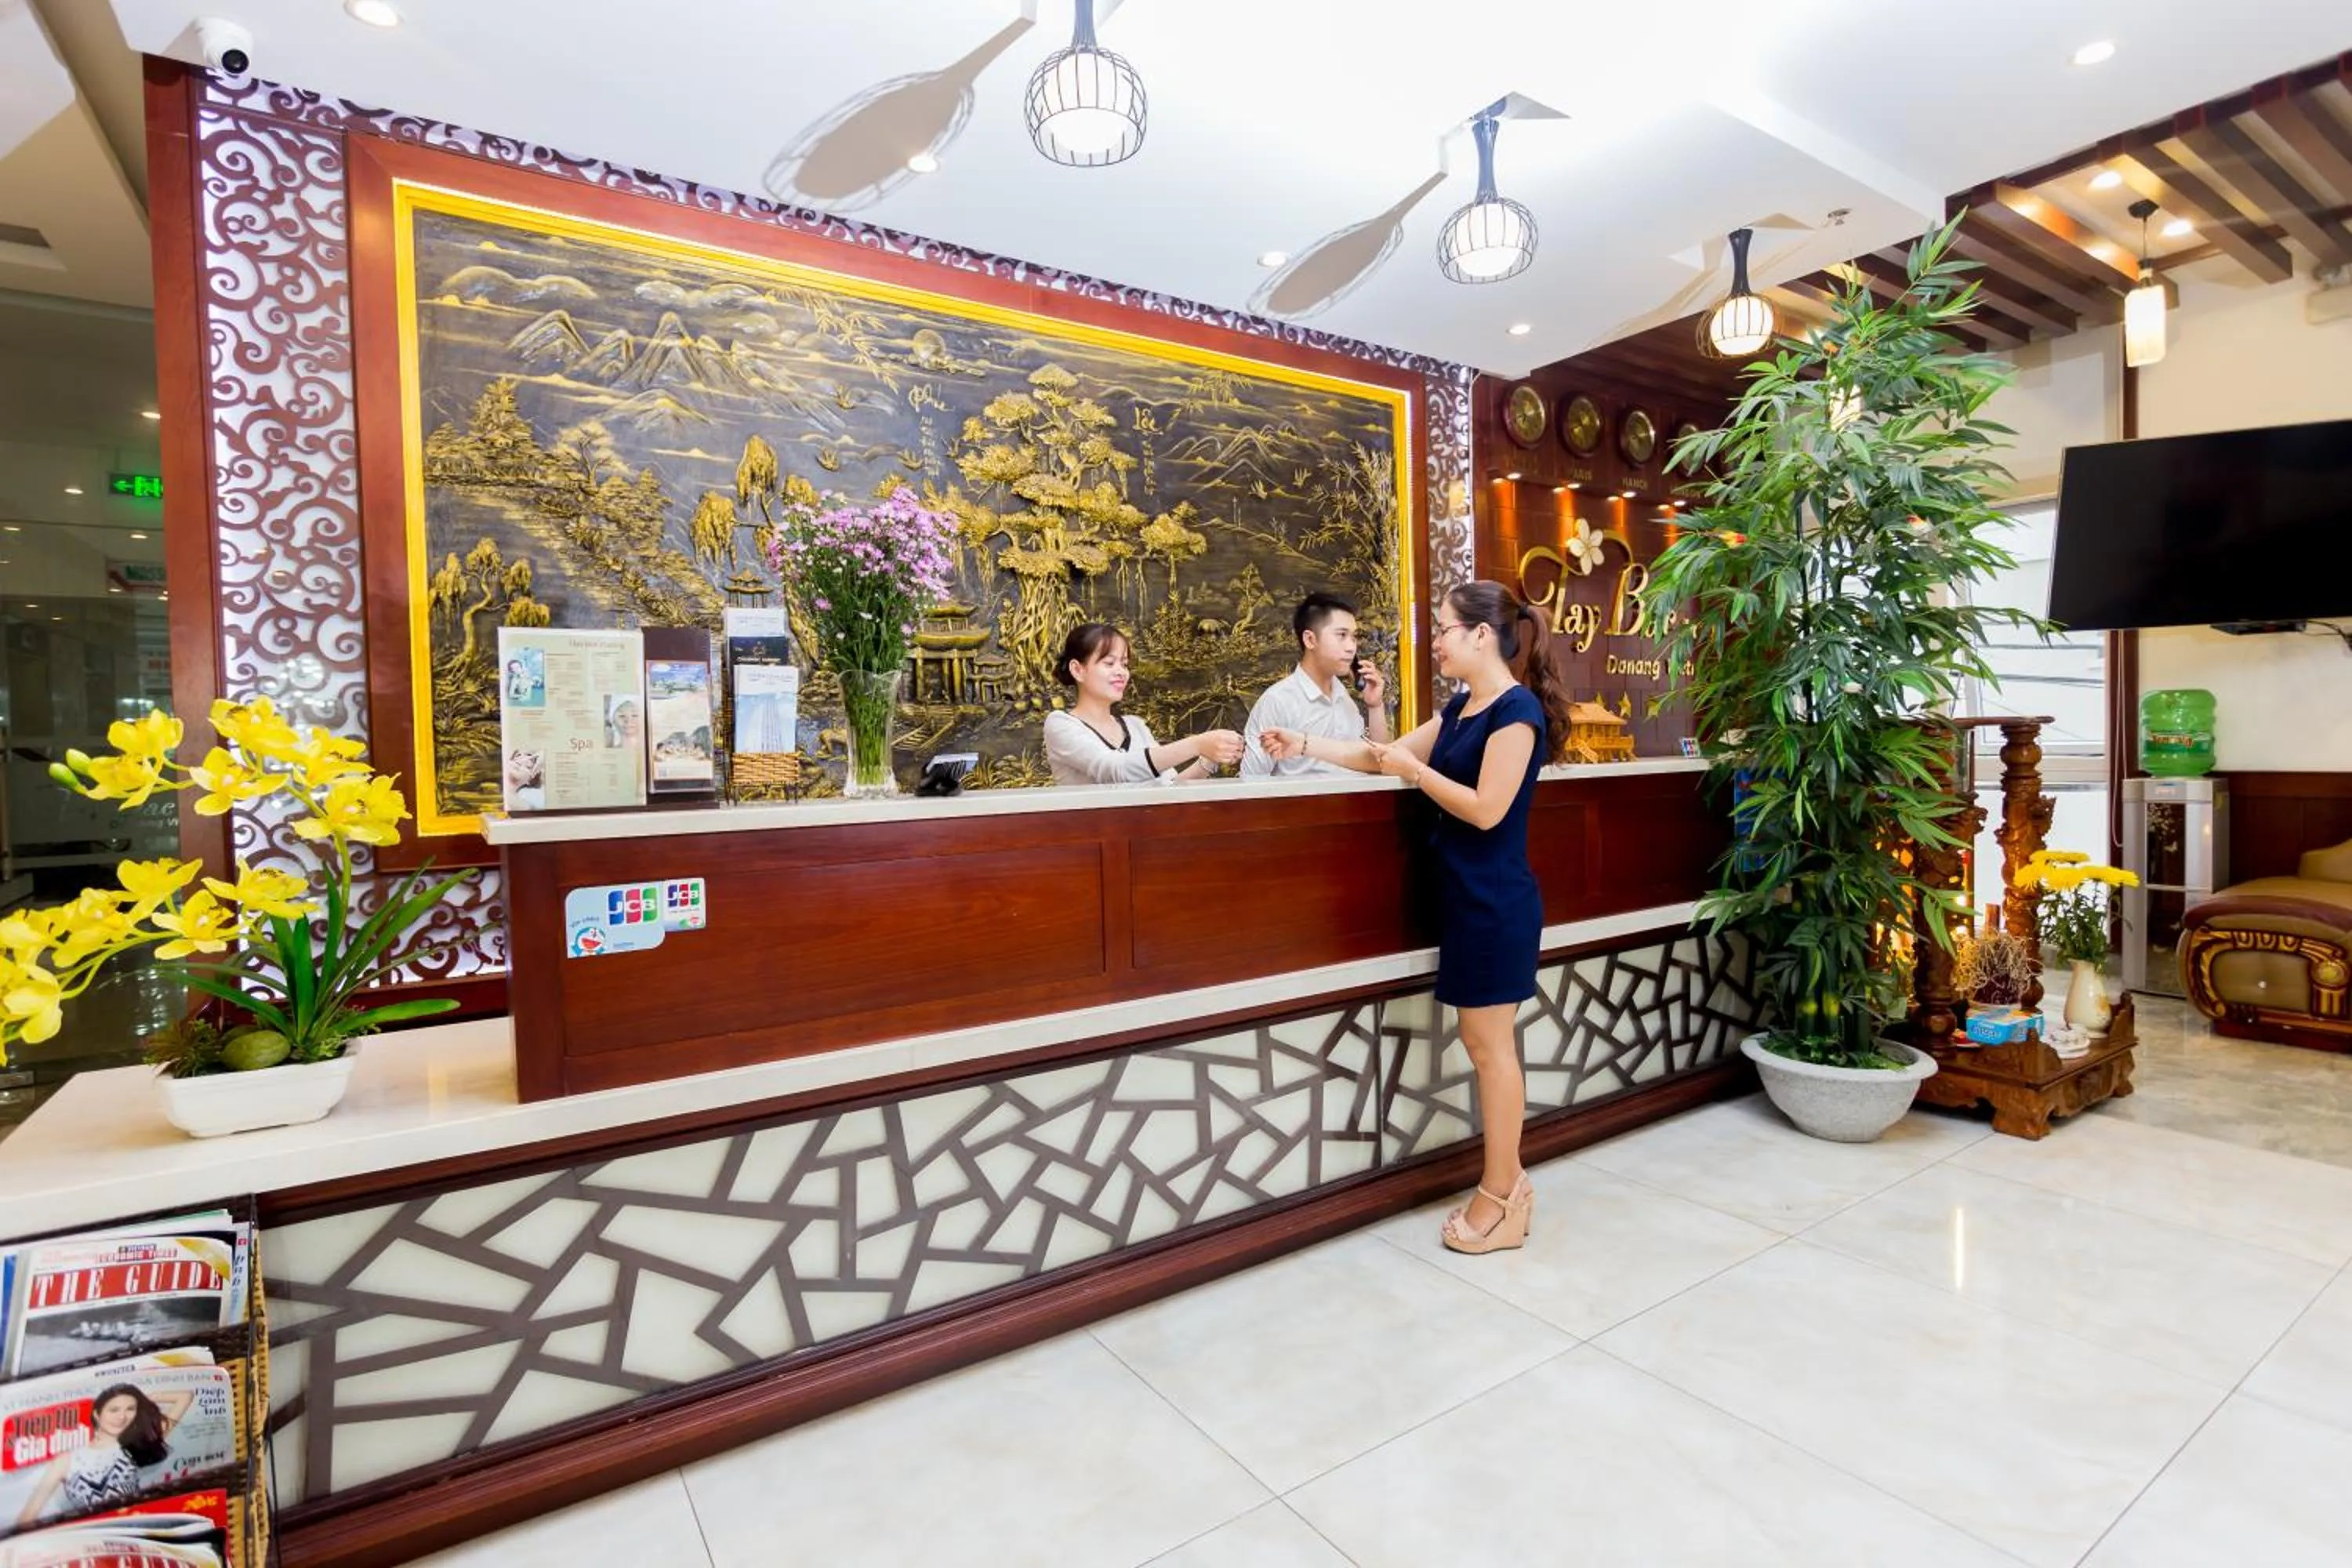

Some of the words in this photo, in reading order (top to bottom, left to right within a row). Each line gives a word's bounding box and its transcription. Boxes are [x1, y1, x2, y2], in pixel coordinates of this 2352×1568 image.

[1519, 546, 1602, 652] Tay
[1607, 654, 1660, 681] Danang
[569, 738, 594, 751] Spa
[608, 887, 659, 925] JCB
[667, 883, 700, 907] JCB
[34, 1268, 105, 1308] THE
[125, 1260, 222, 1295] GUIDE
